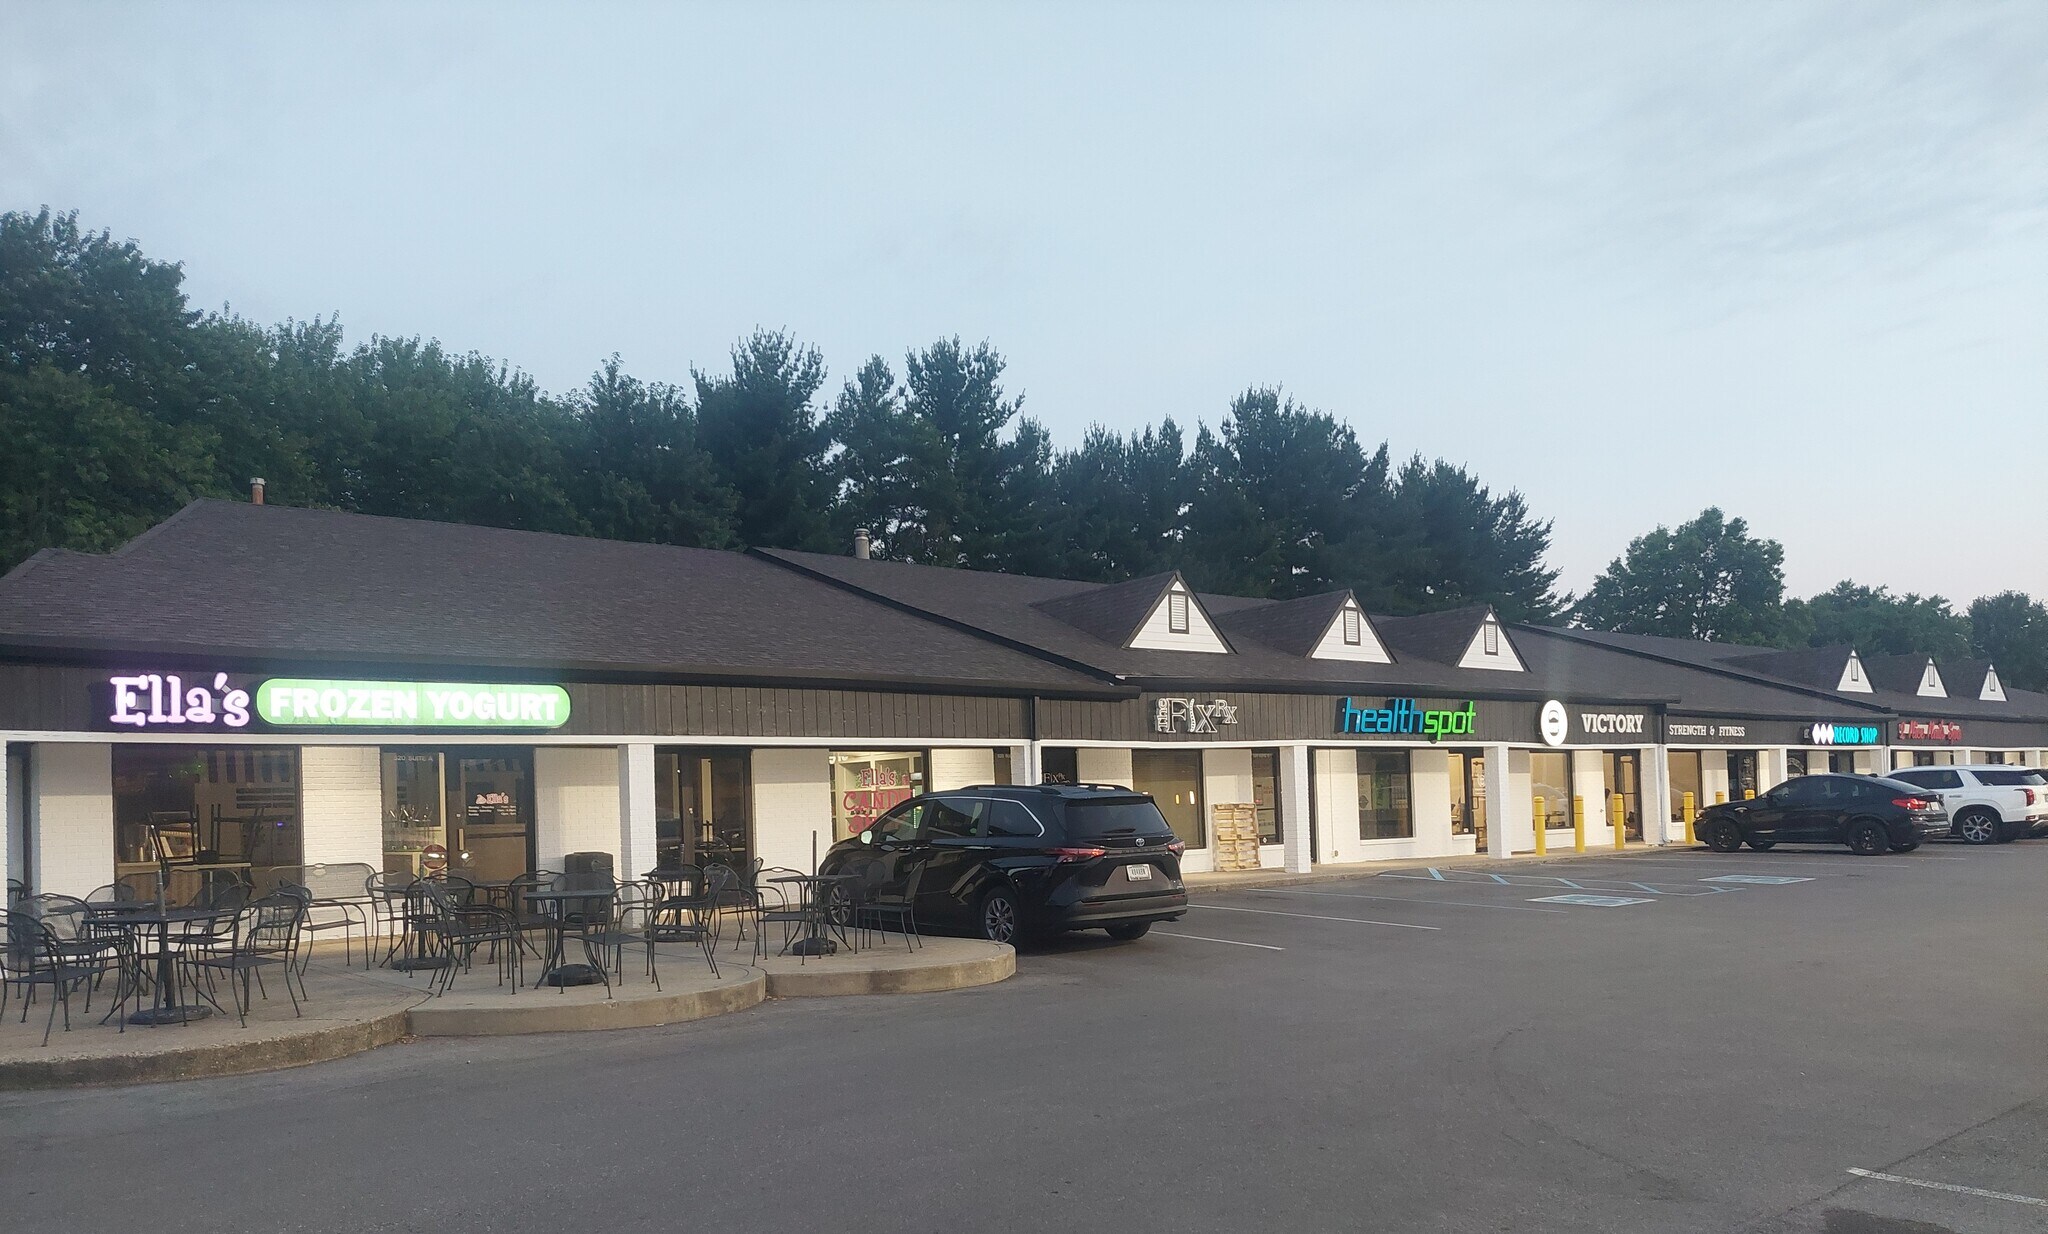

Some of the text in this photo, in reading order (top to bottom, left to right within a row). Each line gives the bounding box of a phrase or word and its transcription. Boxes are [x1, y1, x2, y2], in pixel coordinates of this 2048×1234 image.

[109, 672, 560, 727] Ella's FROZEN YOGURT
[1344, 697, 1476, 741] healthspot
[1581, 713, 1644, 734] VICTORY
[1669, 725, 1746, 737] STRENGTH & FITNESS
[1833, 726, 1878, 744] RECORD SHOP
[860, 766, 897, 787] Ella's
